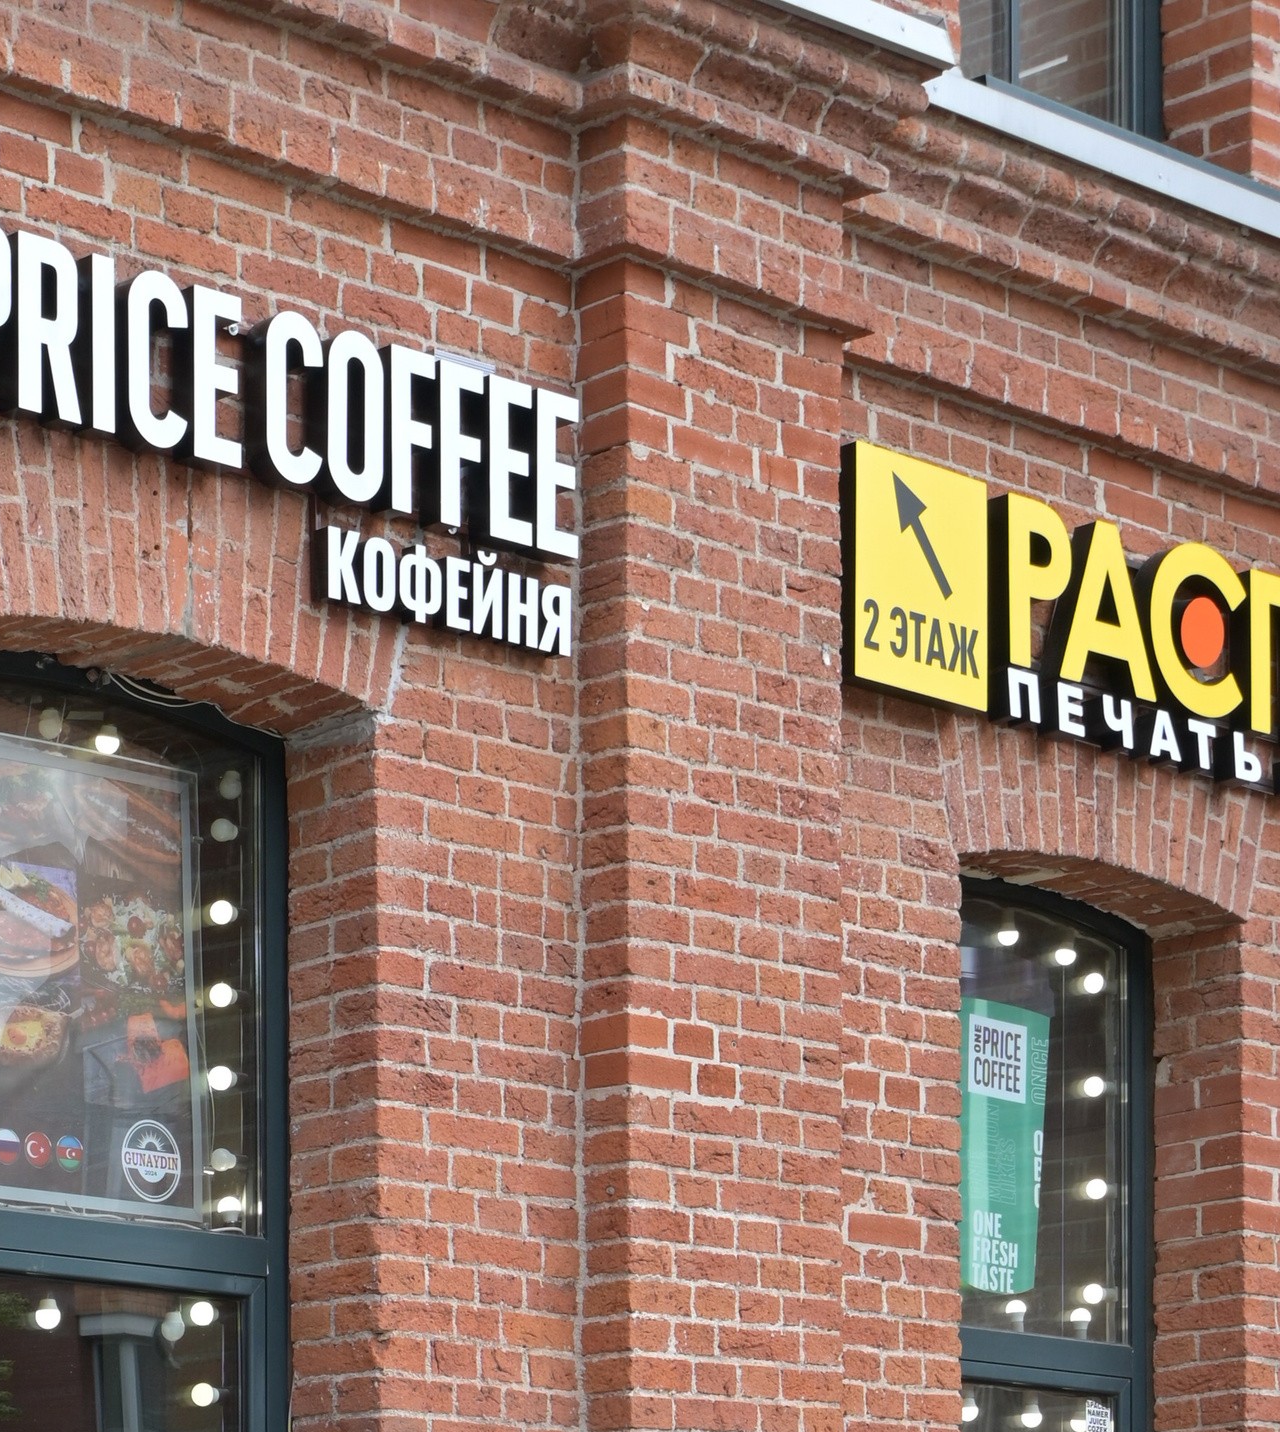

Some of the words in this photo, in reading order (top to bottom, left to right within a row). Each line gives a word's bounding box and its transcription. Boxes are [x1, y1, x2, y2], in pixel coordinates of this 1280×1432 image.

[265, 310, 579, 560] COFFEE
[327, 525, 571, 657] КОФЕЙНЯ
[863, 598, 880, 651] 2
[890, 606, 980, 680] ЭТАЖ
[1008, 667, 1263, 783] ПЕЧАТЬ
[973, 1024, 982, 1053] ONE
[982, 1026, 1022, 1062] PRICE
[974, 1056, 1021, 1094] COFFEE
[1031, 1037, 1049, 1106] ONCE
[124, 1151, 178, 1171] GUNAYDIN
[973, 1209, 1002, 1239] ONE
[973, 1236, 1018, 1268] FRESH
[972, 1262, 1015, 1294] TASTE
[1088, 1417, 1107, 1427] JUICE
